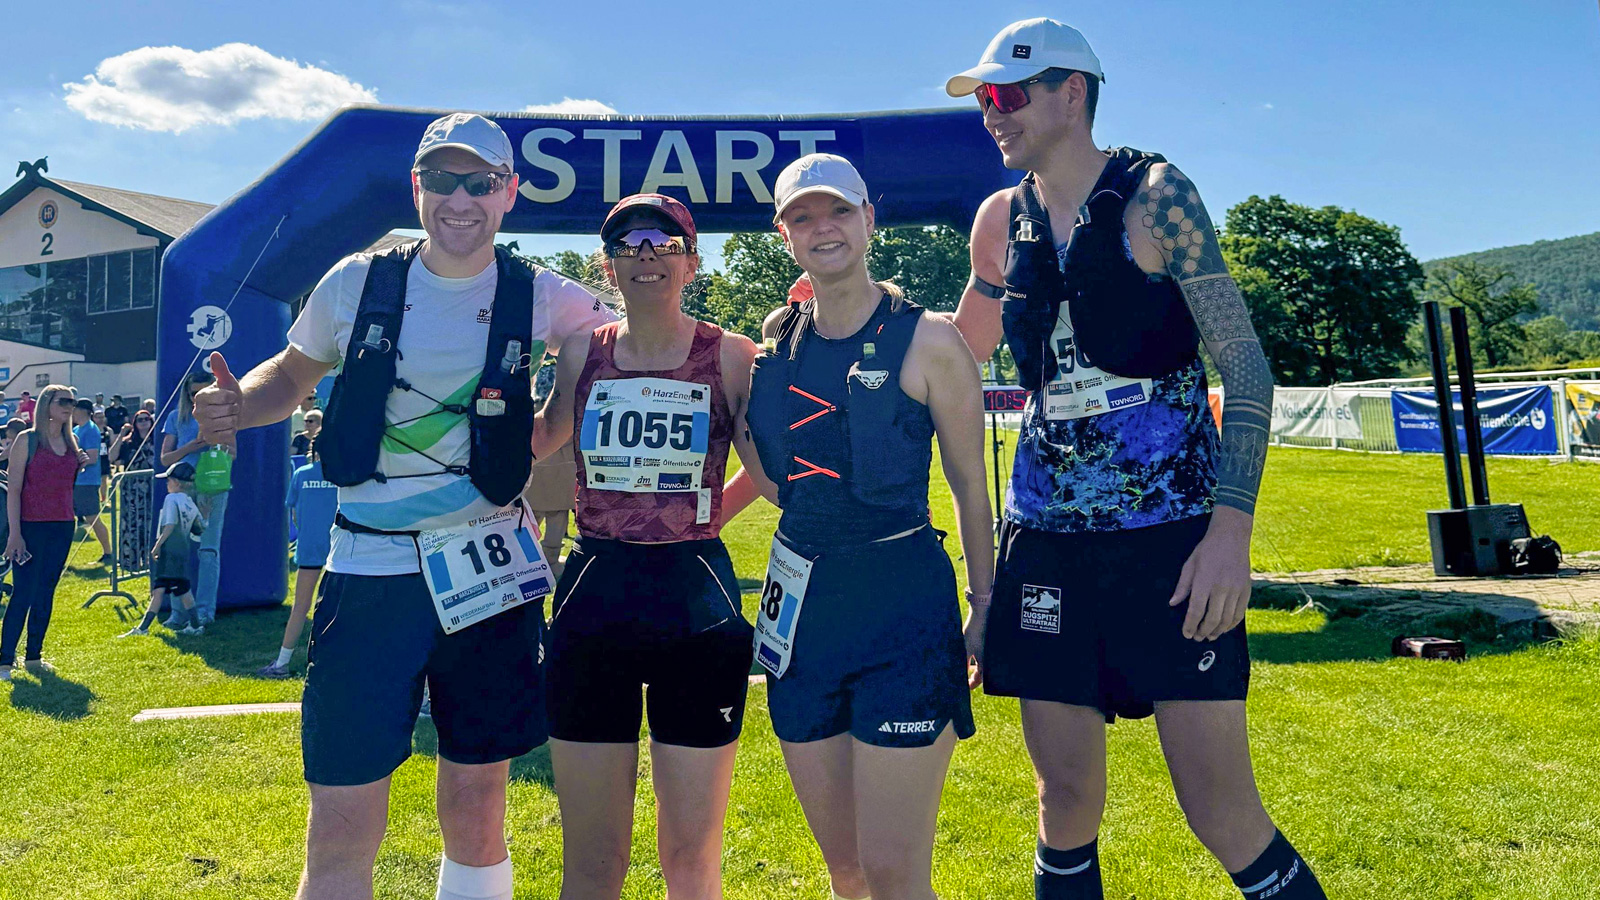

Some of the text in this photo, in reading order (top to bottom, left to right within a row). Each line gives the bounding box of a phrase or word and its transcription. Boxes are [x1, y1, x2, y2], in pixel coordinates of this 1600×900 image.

[518, 127, 836, 204] START
[40, 232, 54, 256] 2
[985, 390, 1027, 411] 10:5
[1086, 398, 1100, 408] dm
[1335, 405, 1352, 420] eG
[1480, 411, 1531, 429] ffentliche
[598, 410, 693, 451] 1055
[637, 475, 651, 484] dm
[460, 533, 512, 576] 18
[501, 592, 515, 602] dm
[1022, 618, 1057, 628] ULTRATRAIL
[1023, 610, 1058, 622] ZUGSPITZ
[893, 720, 935, 733] TERREX
[1281, 859, 1299, 887] cep
